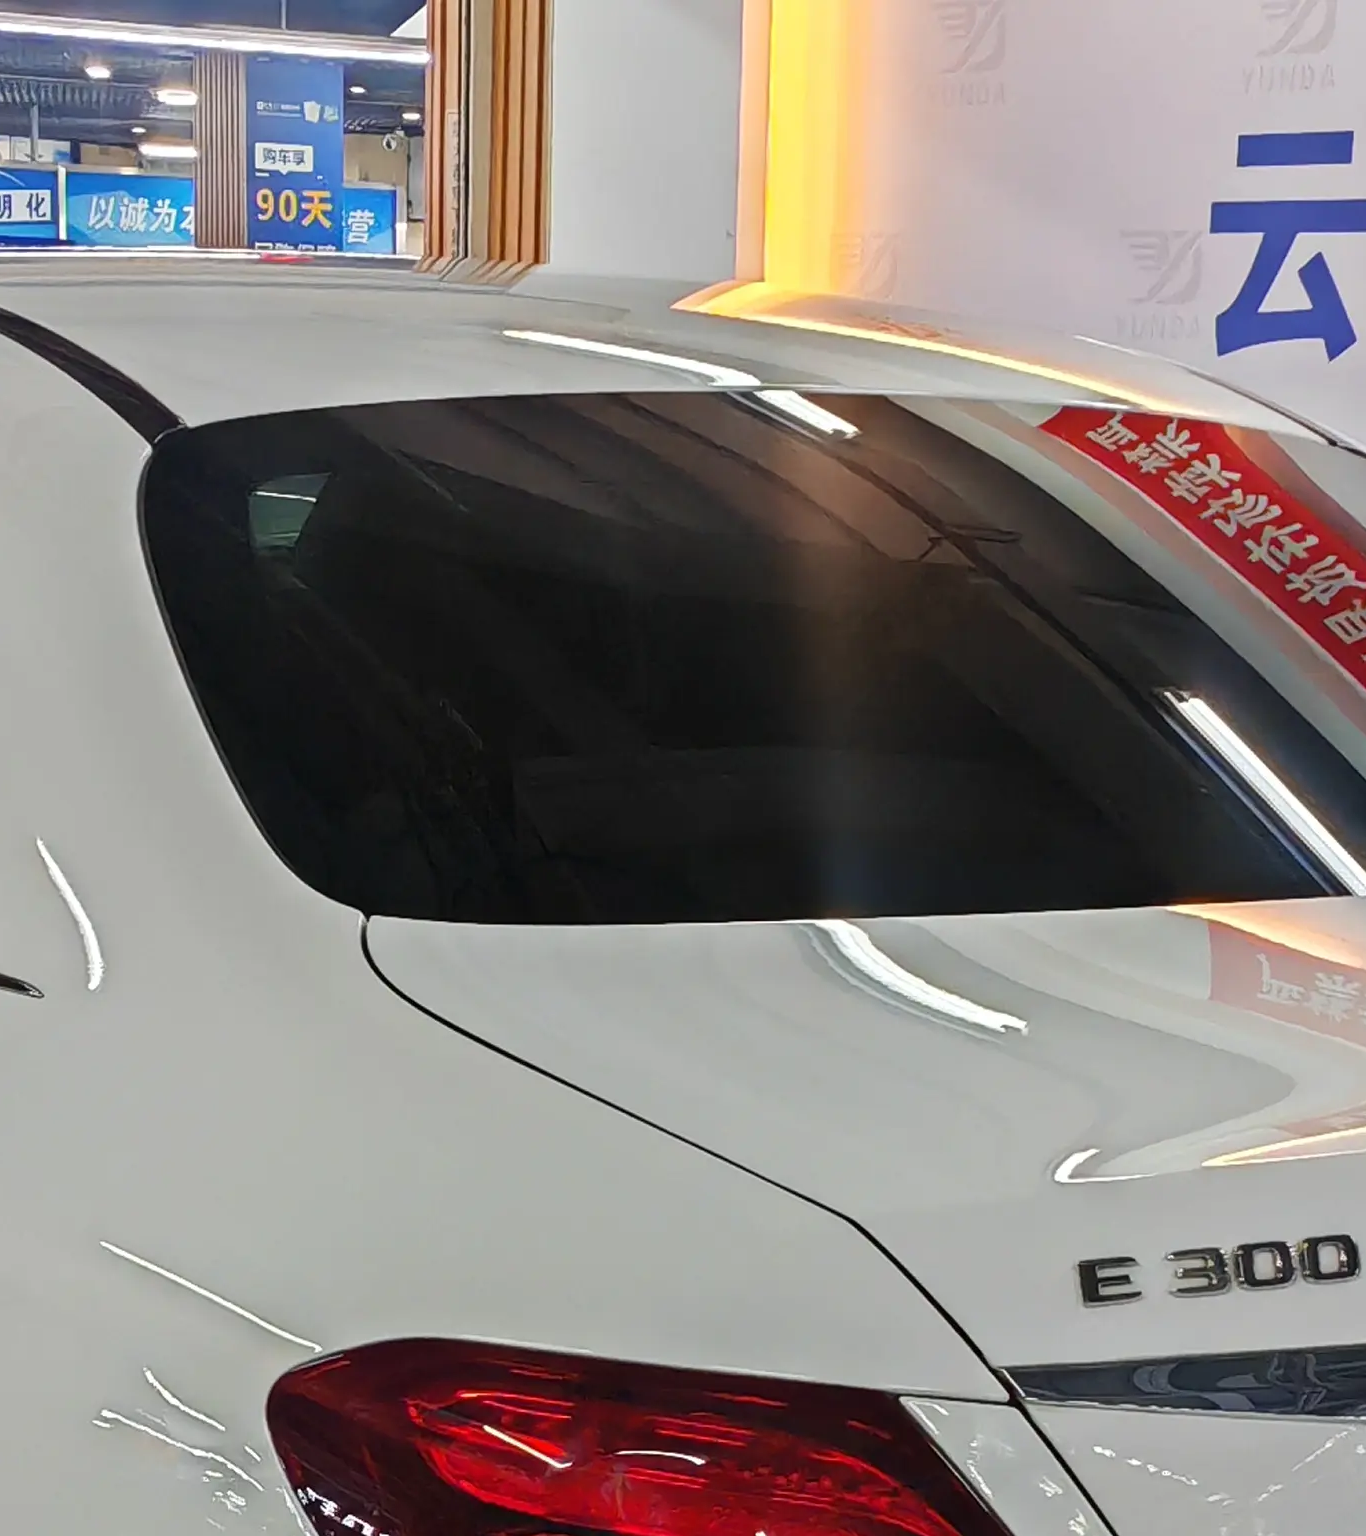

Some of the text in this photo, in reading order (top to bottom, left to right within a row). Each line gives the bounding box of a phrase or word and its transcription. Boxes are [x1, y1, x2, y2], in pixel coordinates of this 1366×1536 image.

[256, 188, 333, 229] 90天
[1074, 1256, 1143, 1309] E
[1164, 1233, 1363, 1298] 300
